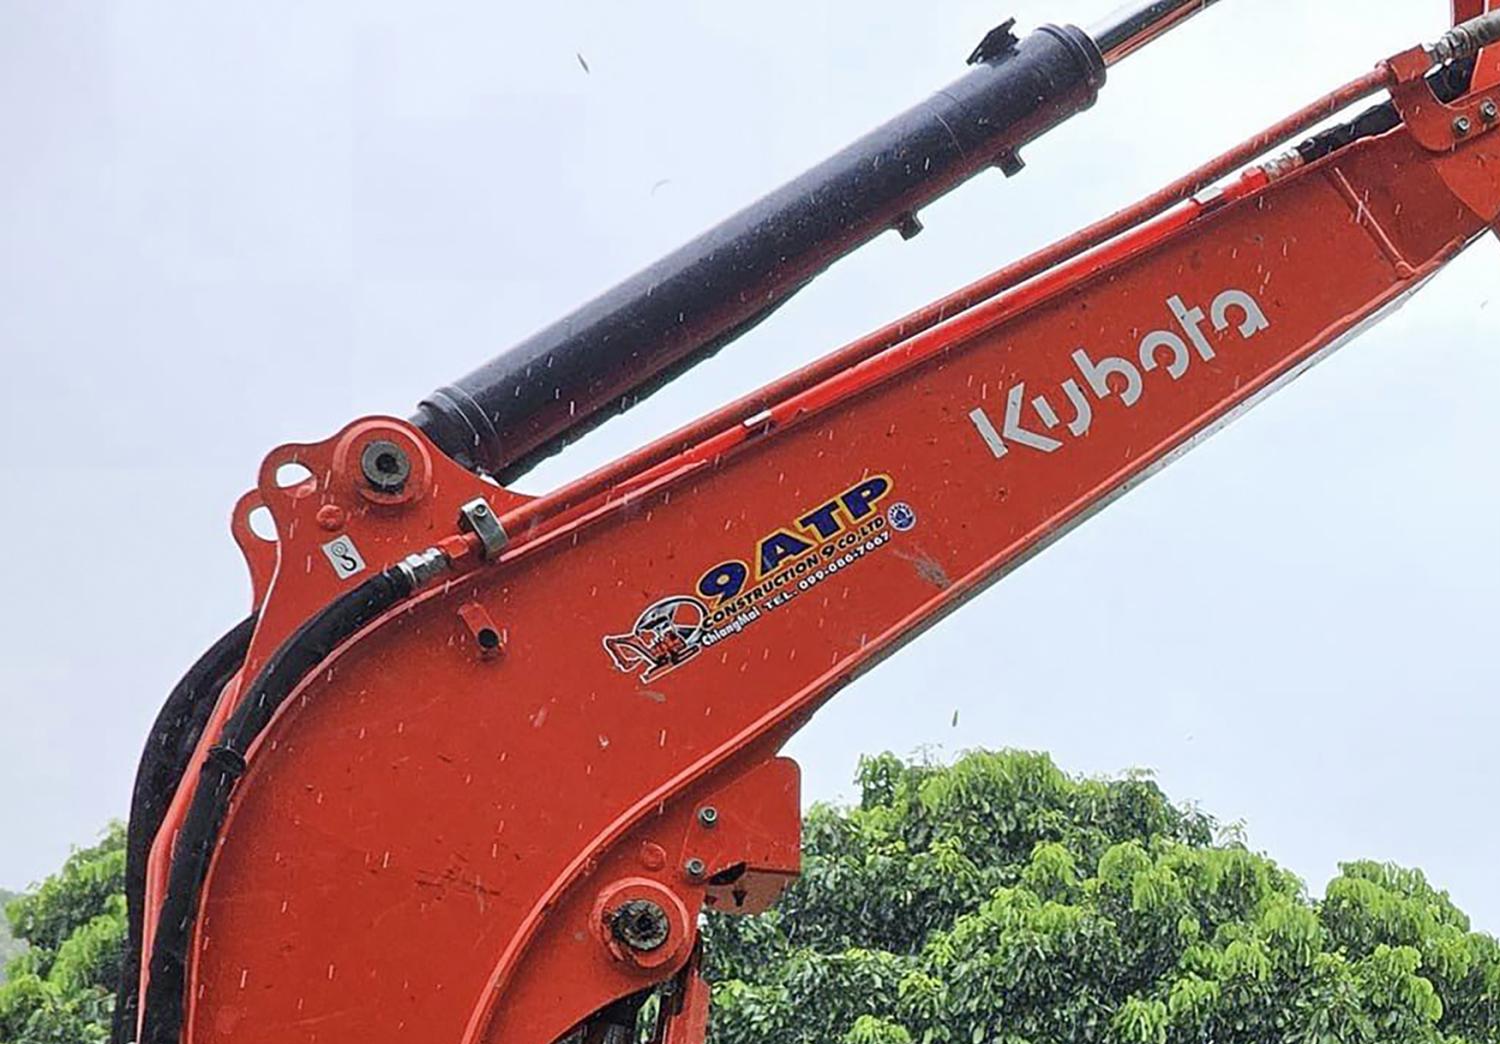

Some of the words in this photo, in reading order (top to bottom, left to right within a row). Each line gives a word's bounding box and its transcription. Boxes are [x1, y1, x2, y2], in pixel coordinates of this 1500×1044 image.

[969, 289, 1269, 458] Kubota
[701, 555, 819, 628] CONSTRUCTION
[821, 543, 836, 559] 9
